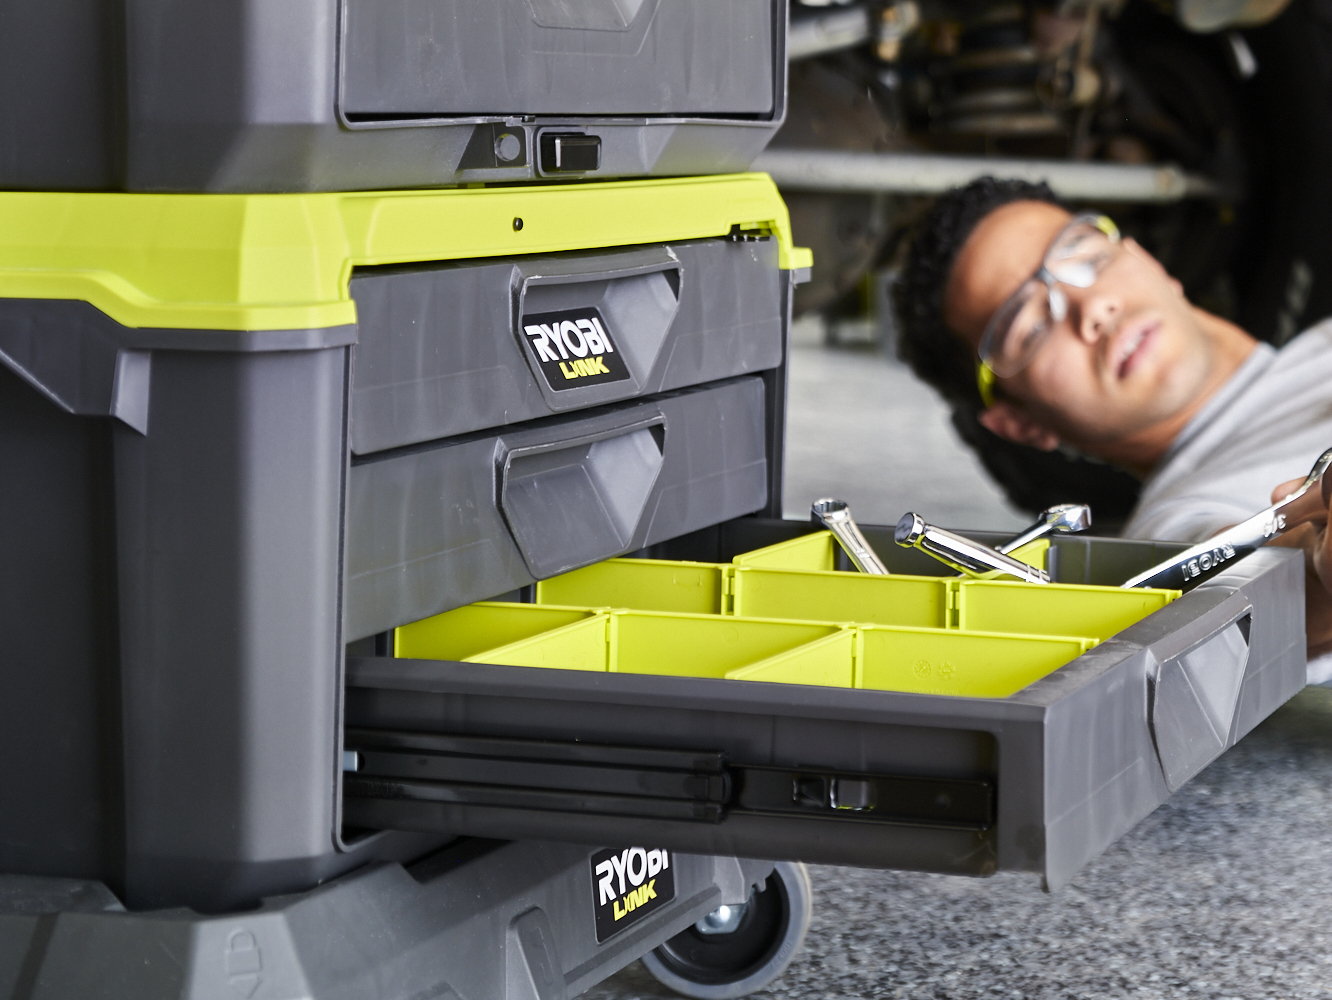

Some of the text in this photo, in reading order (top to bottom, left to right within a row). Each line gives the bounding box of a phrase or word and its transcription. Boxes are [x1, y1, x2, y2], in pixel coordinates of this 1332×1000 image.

[524, 317, 614, 363] RYOBI
[559, 356, 610, 380] LINK
[1263, 513, 1287, 538] 3/4
[1181, 541, 1236, 582] RYOBI
[613, 879, 658, 921] LINK
